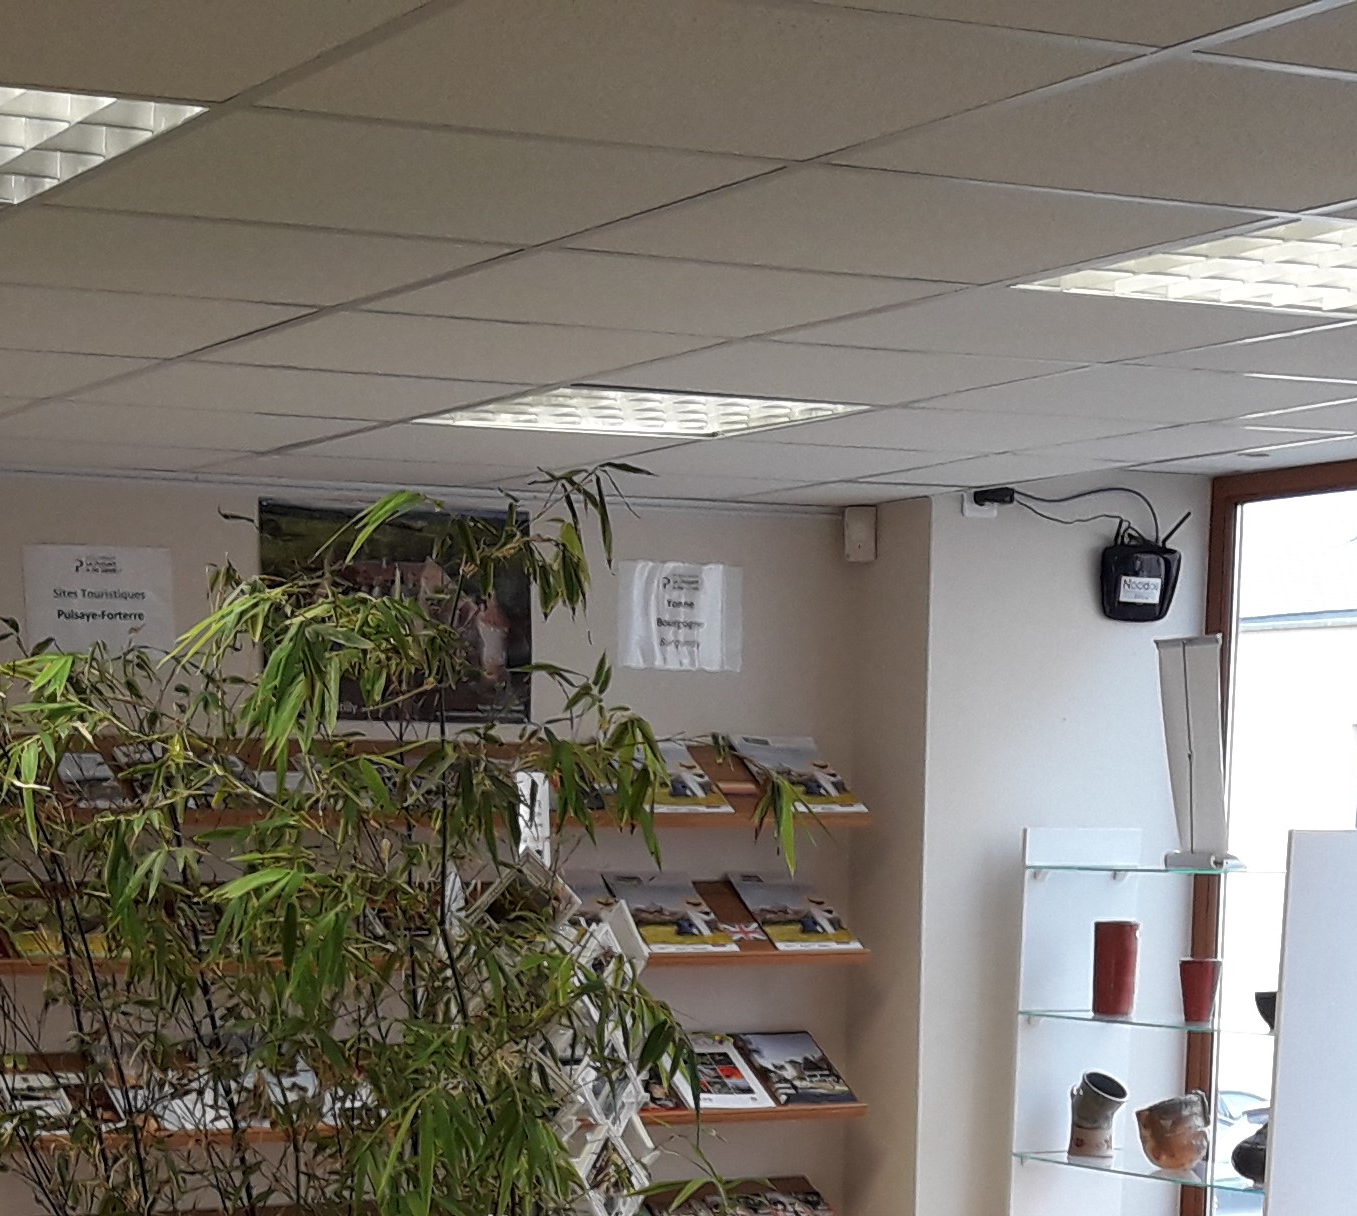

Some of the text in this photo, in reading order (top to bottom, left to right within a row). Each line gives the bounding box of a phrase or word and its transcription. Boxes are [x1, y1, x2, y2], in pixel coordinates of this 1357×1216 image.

[52, 588, 146, 601] Sites Touristiques
[57, 609, 146, 622] Puisaye-Forterre
[656, 617, 705, 630] Bourgogne
